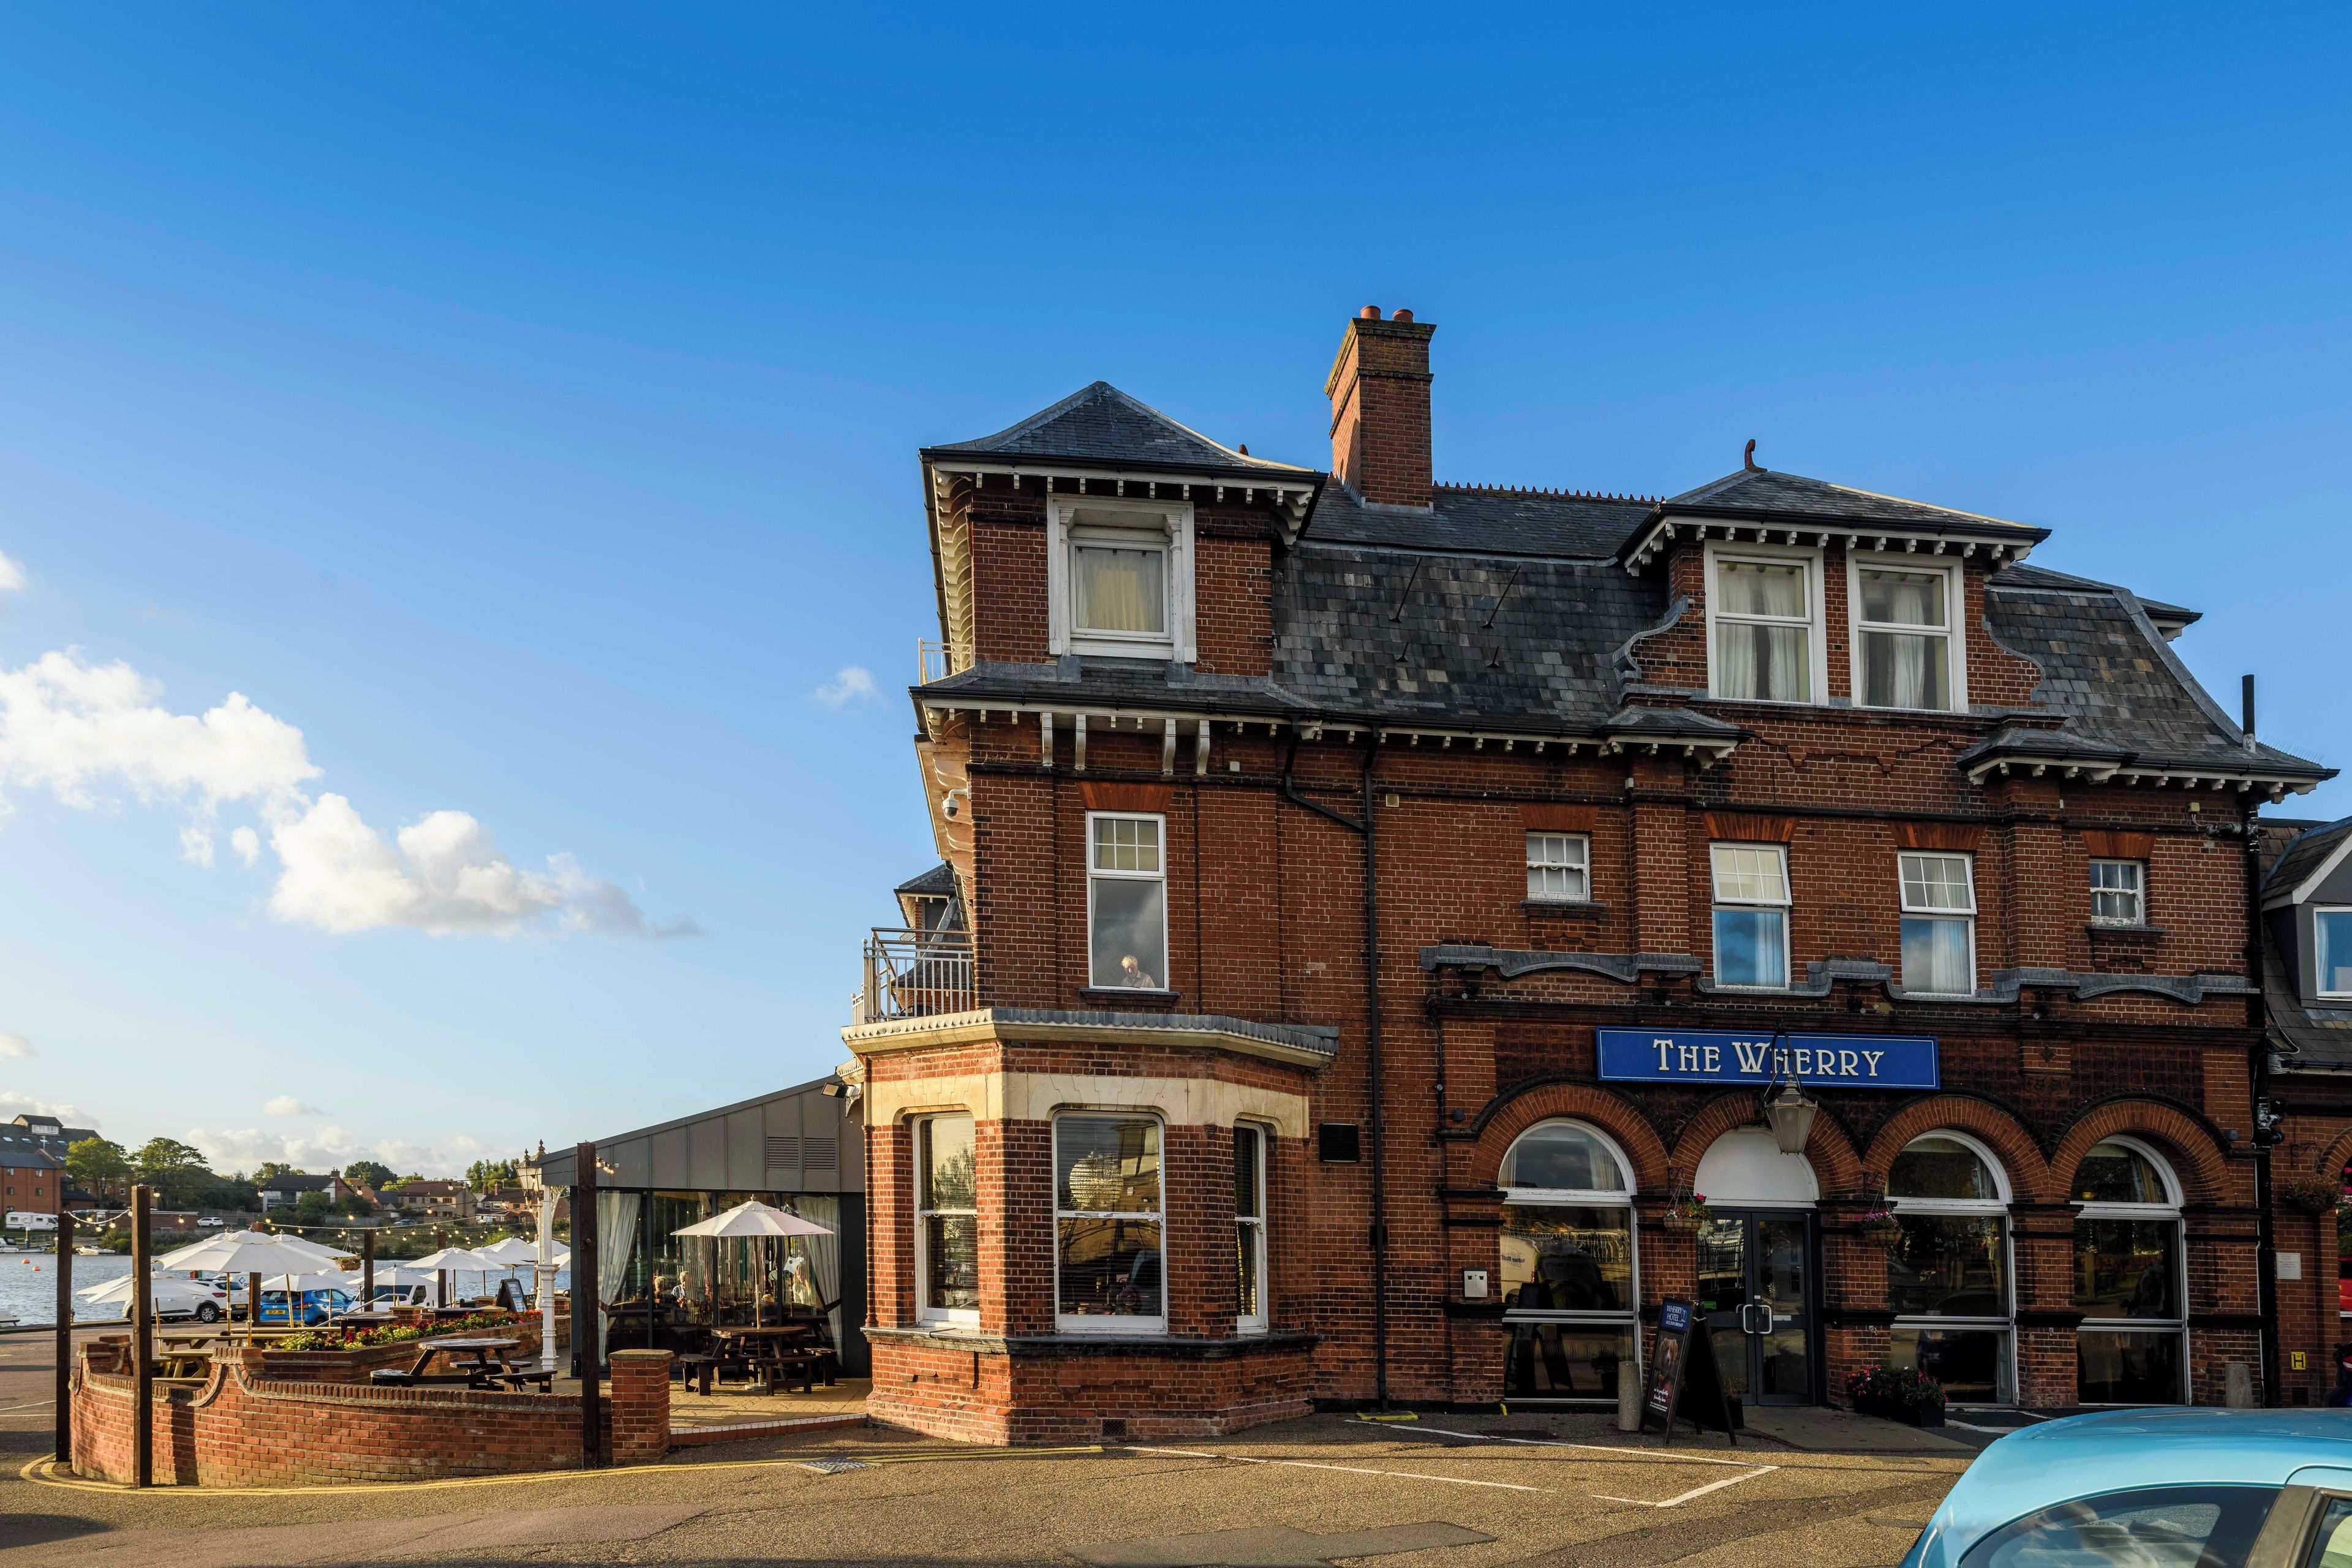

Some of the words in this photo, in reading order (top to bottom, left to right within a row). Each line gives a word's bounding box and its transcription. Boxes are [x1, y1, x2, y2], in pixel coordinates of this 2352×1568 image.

[1667, 1305, 1682, 1314] WHERRY
[1667, 1313, 1679, 1322] HOTEL
[2293, 1354, 2304, 1368] H
